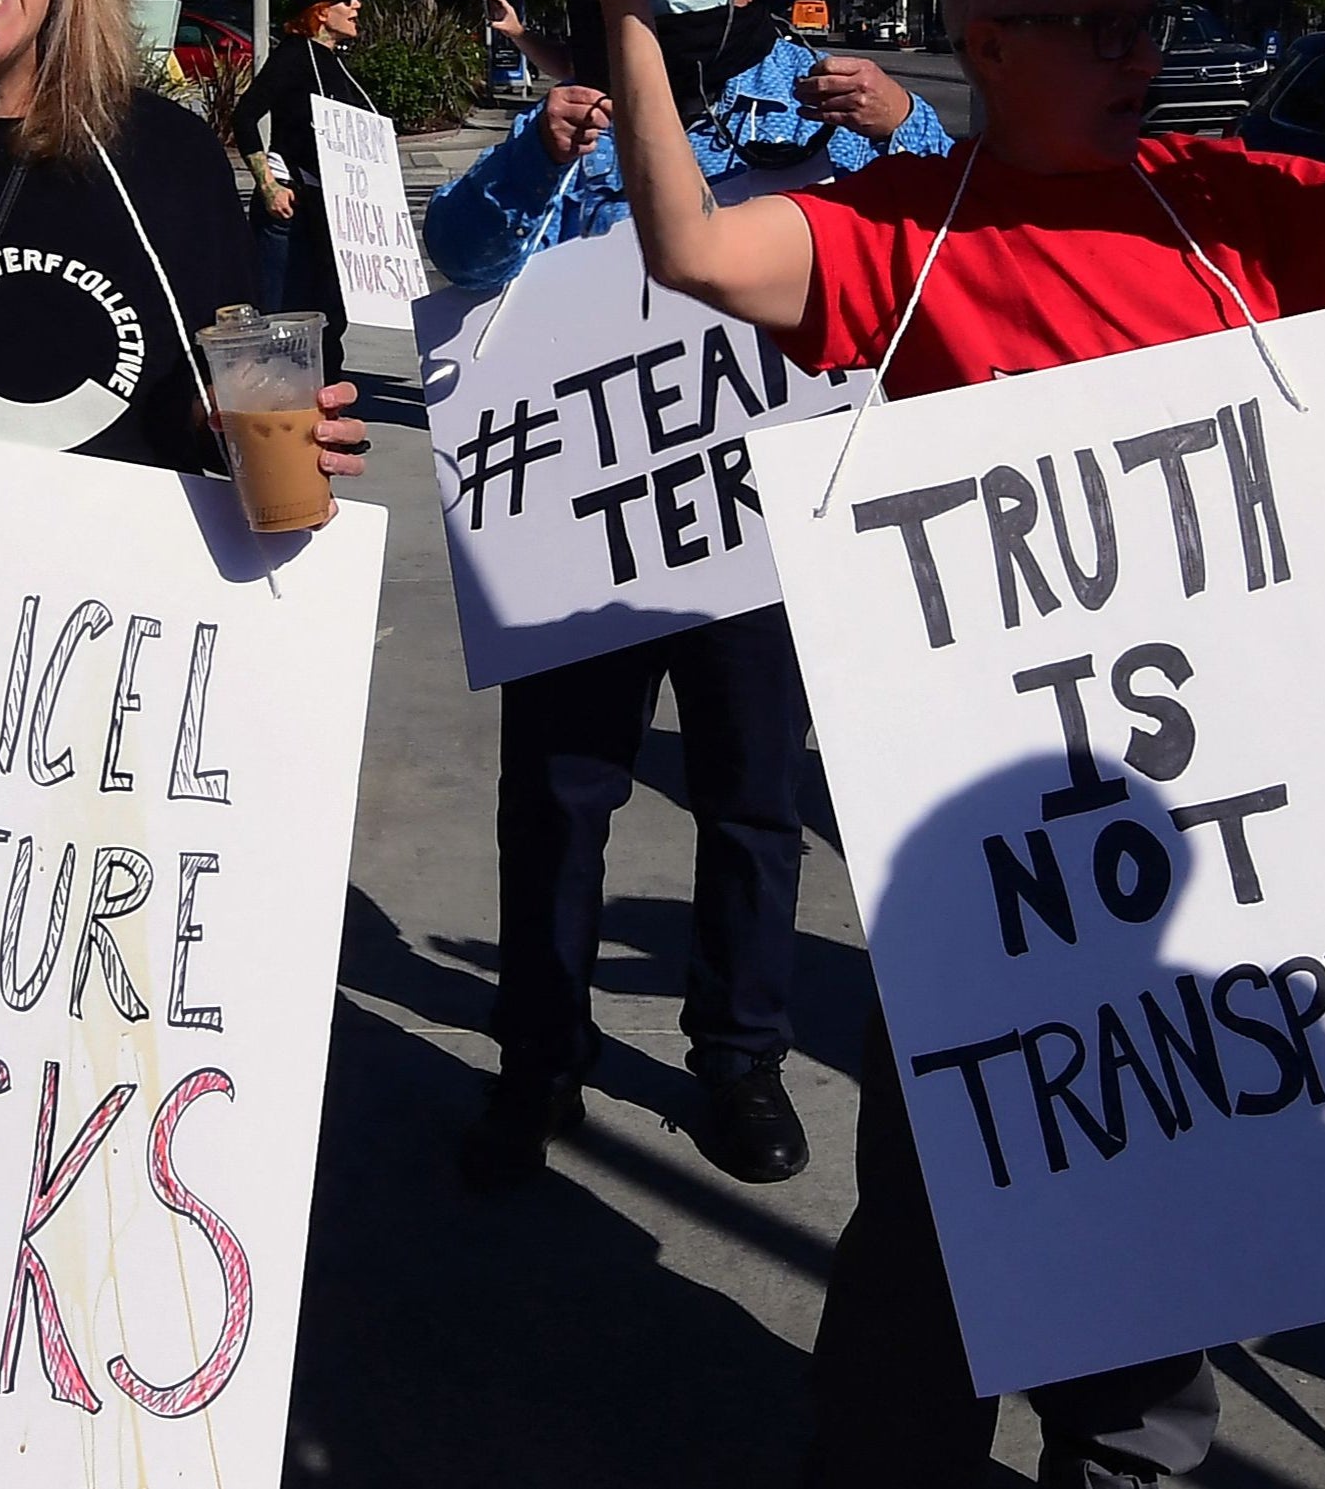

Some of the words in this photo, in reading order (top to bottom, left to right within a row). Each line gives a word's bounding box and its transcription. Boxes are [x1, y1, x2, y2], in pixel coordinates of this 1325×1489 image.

[323, 108, 388, 165] LEARN
[344, 162, 369, 199] TO
[334, 195, 388, 247] LAUGH
[395, 211, 415, 250] AT
[339, 249, 425, 302] YOURSELF
[62, 259, 145, 398] COLLECTIVE
[572, 404, 850, 586] TER
[851, 396, 1291, 650] TRUTH
[1013, 641, 1197, 822] IS
[982, 783, 1290, 958] NOT
